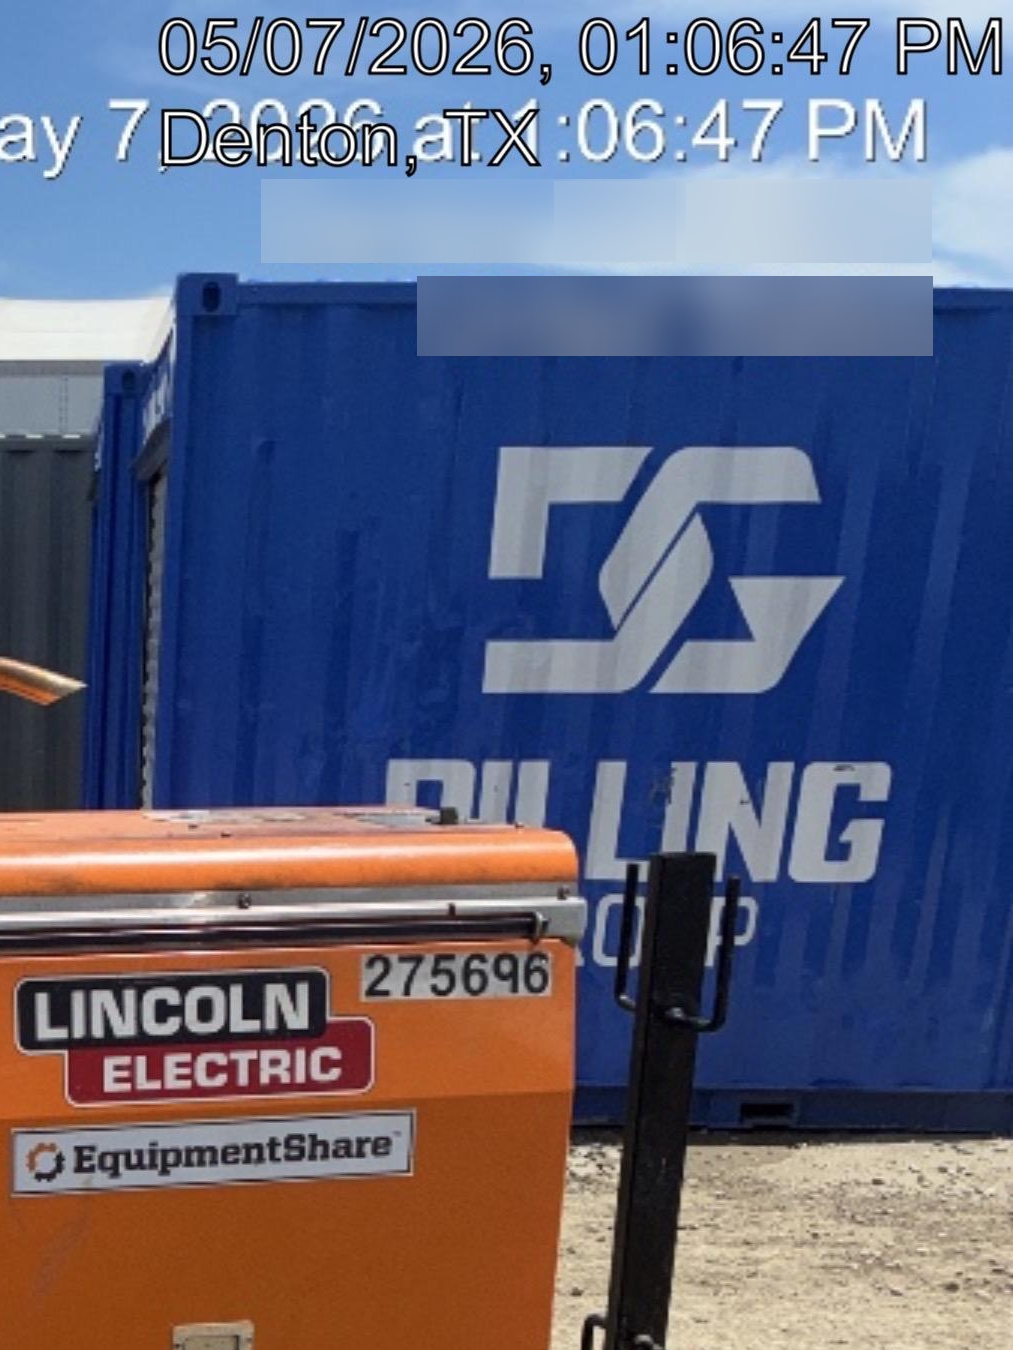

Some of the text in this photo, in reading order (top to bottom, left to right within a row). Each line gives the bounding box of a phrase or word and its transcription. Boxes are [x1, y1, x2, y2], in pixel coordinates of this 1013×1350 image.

[365, 952, 549, 998] 275696
[34, 981, 310, 1041] LINCOLN
[102, 1045, 342, 1093] ELECTRIC
[73, 1132, 392, 1178] EquipmentShare
